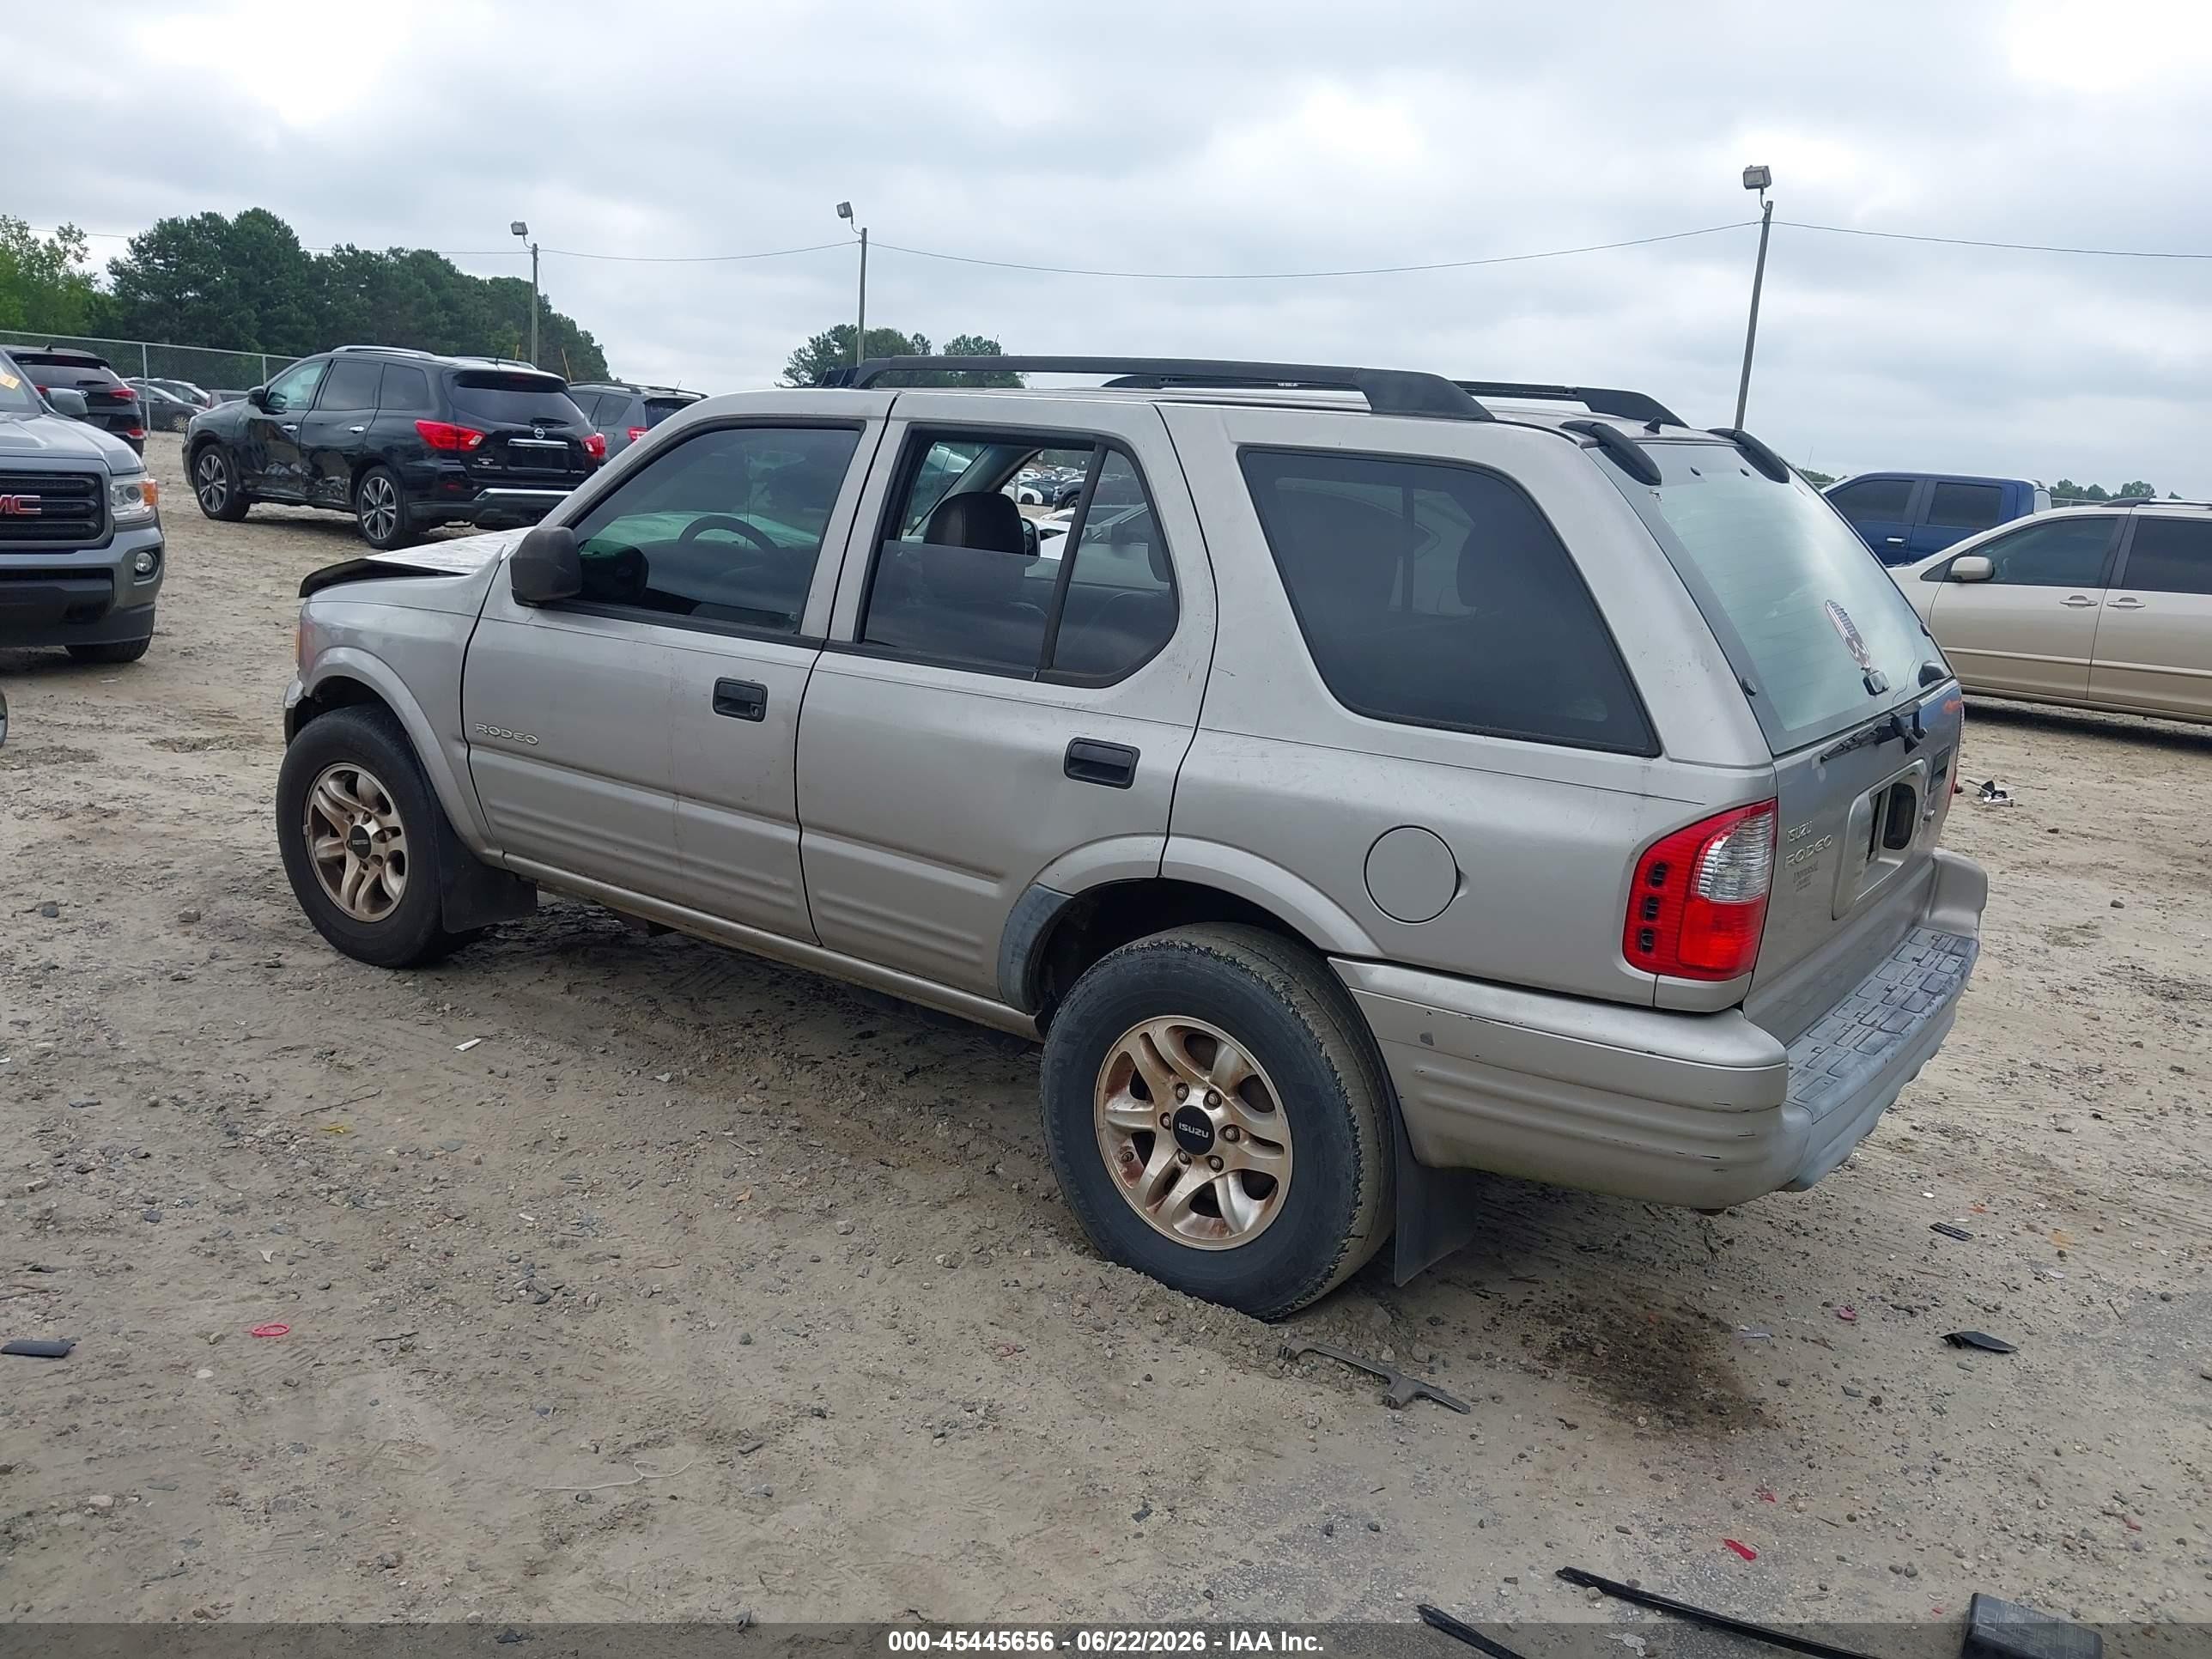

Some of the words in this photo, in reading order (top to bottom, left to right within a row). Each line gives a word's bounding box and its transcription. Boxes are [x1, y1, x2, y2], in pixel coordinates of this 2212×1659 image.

[474, 722, 539, 745] RODEO
[1785, 834, 1833, 870] RODEO
[1178, 1121, 1209, 1139] ISUZU
